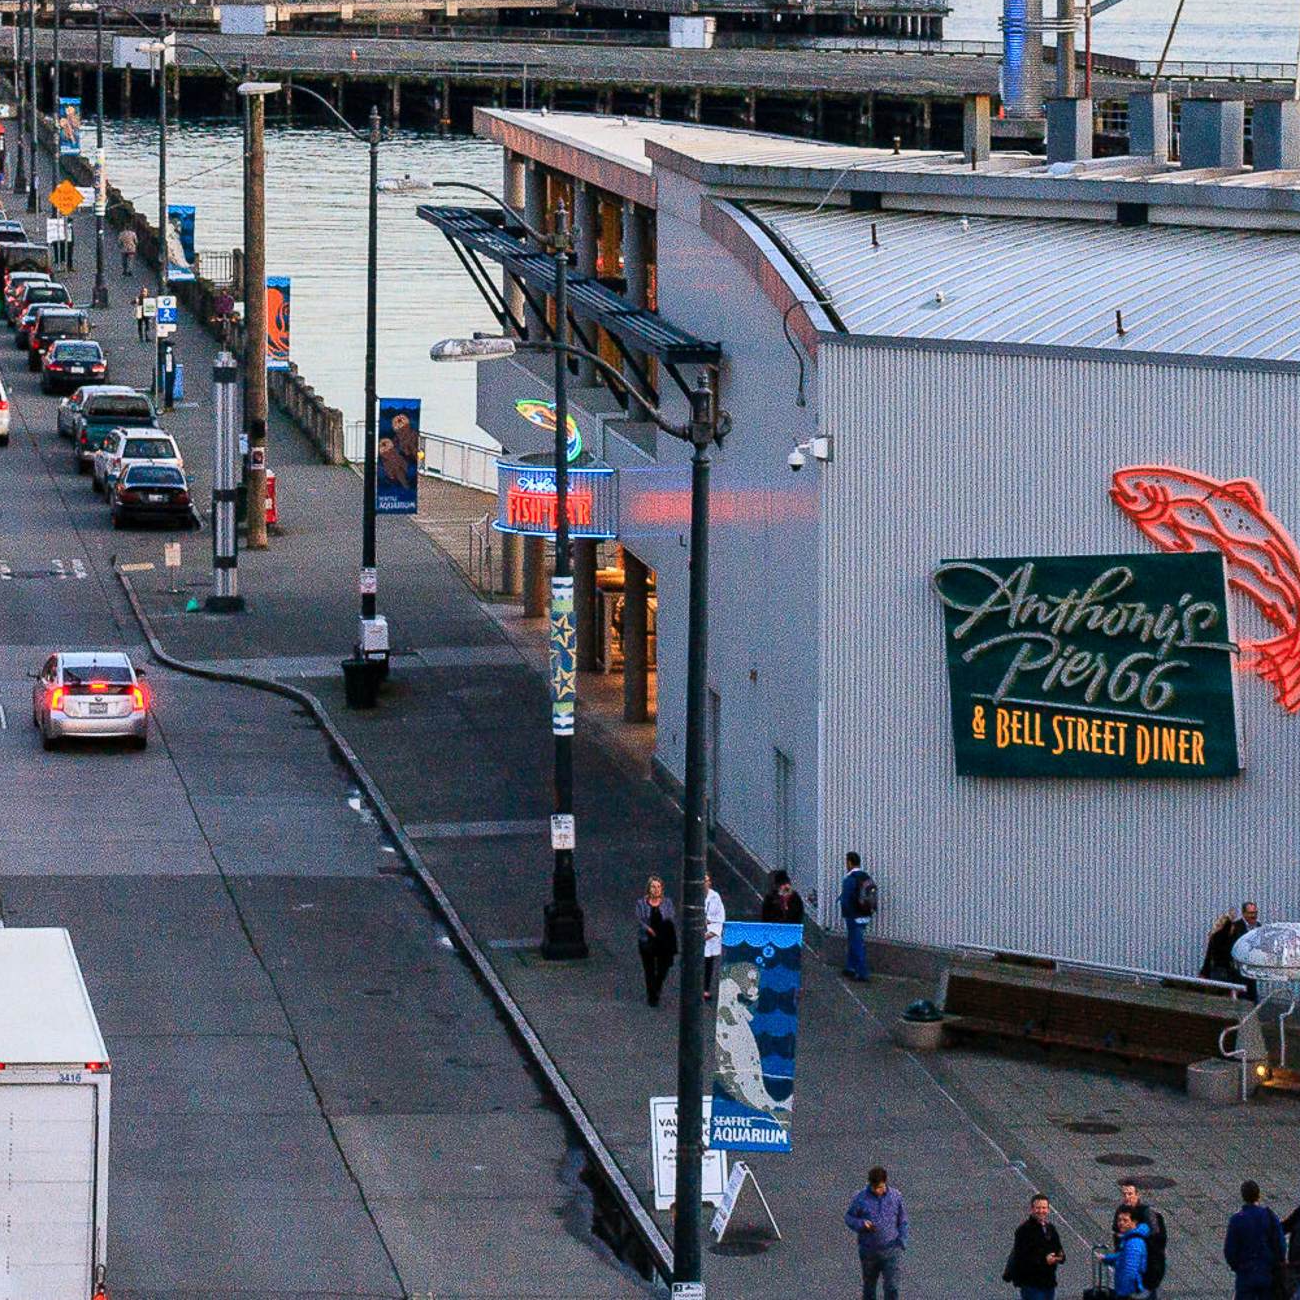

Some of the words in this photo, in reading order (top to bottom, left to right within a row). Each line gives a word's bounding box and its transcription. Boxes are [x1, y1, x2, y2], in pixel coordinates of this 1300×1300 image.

[931, 562, 1238, 658] Anthony's
[961, 631, 1107, 704] Pier
[1107, 652, 1190, 712] 66
[971, 704, 987, 739] &
[995, 707, 1045, 749] BELL
[1052, 714, 1128, 756] STREET
[1135, 723, 1205, 766] DINER
[713, 1115, 752, 1128] SEATTLE
[713, 1127, 788, 1144] AQUARIUM
